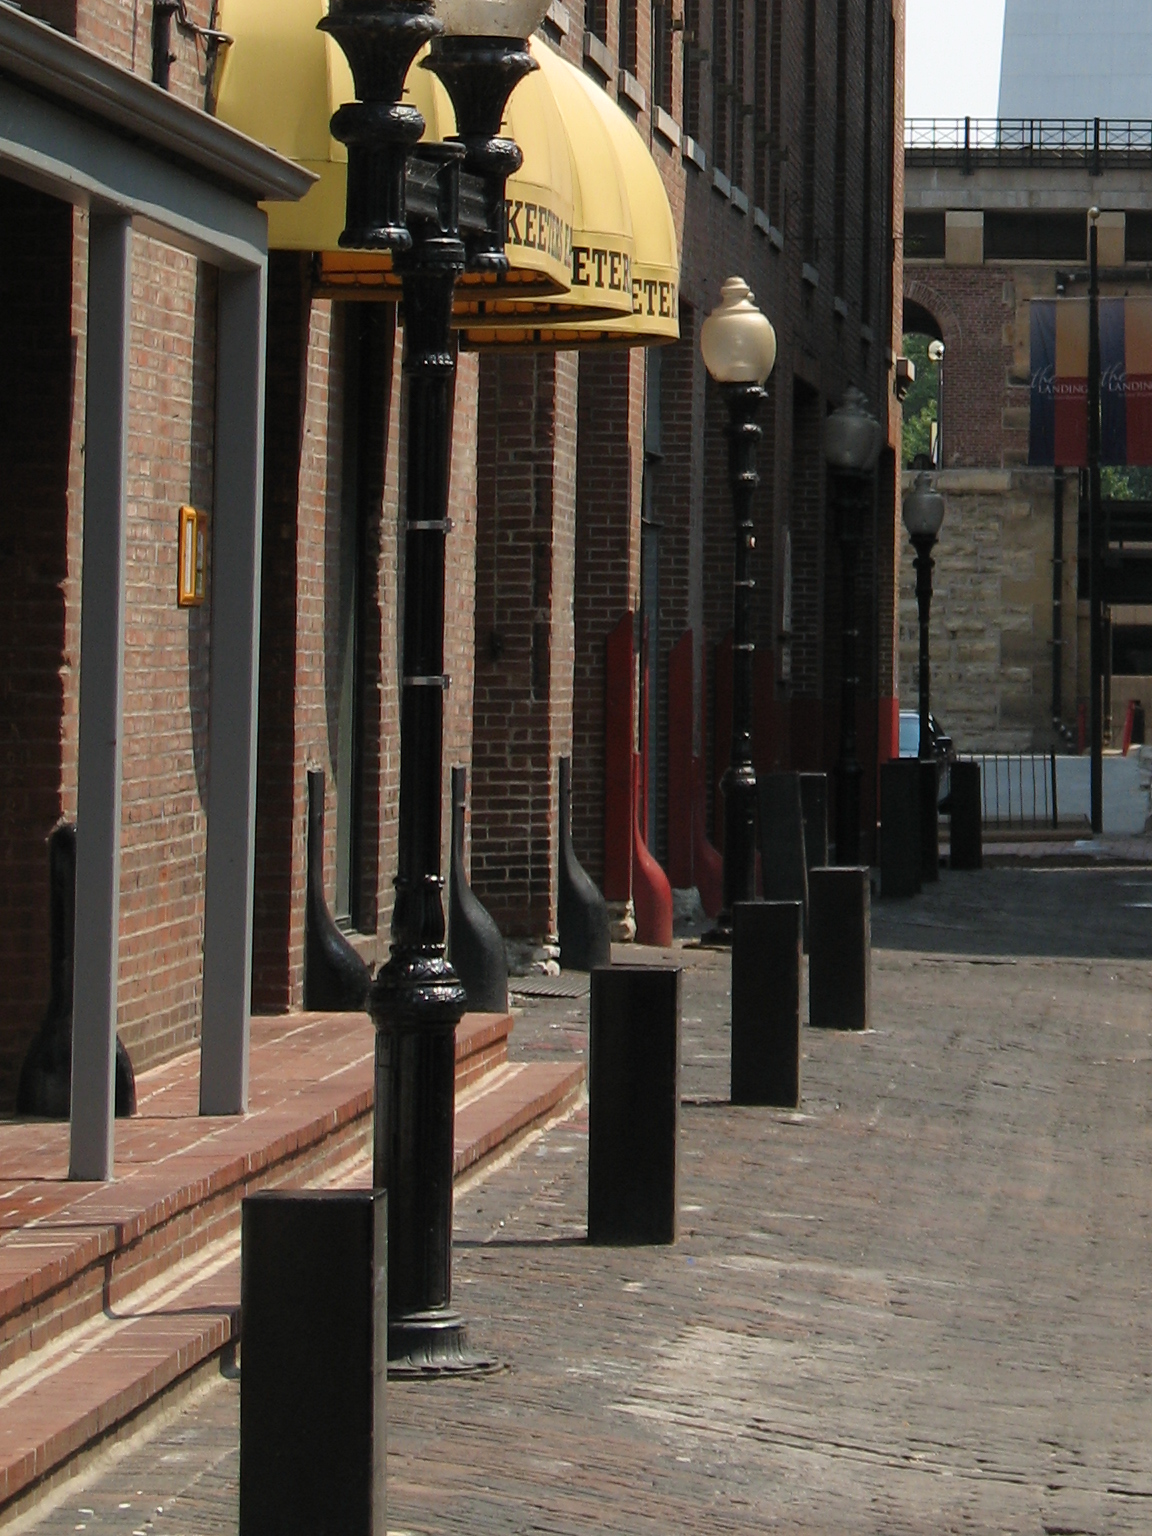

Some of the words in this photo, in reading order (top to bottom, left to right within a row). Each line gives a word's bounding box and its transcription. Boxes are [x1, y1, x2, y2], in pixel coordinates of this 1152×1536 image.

[1031, 363, 1057, 388] the
[1101, 361, 1127, 387] the
[1038, 384, 1088, 394] LANDING
